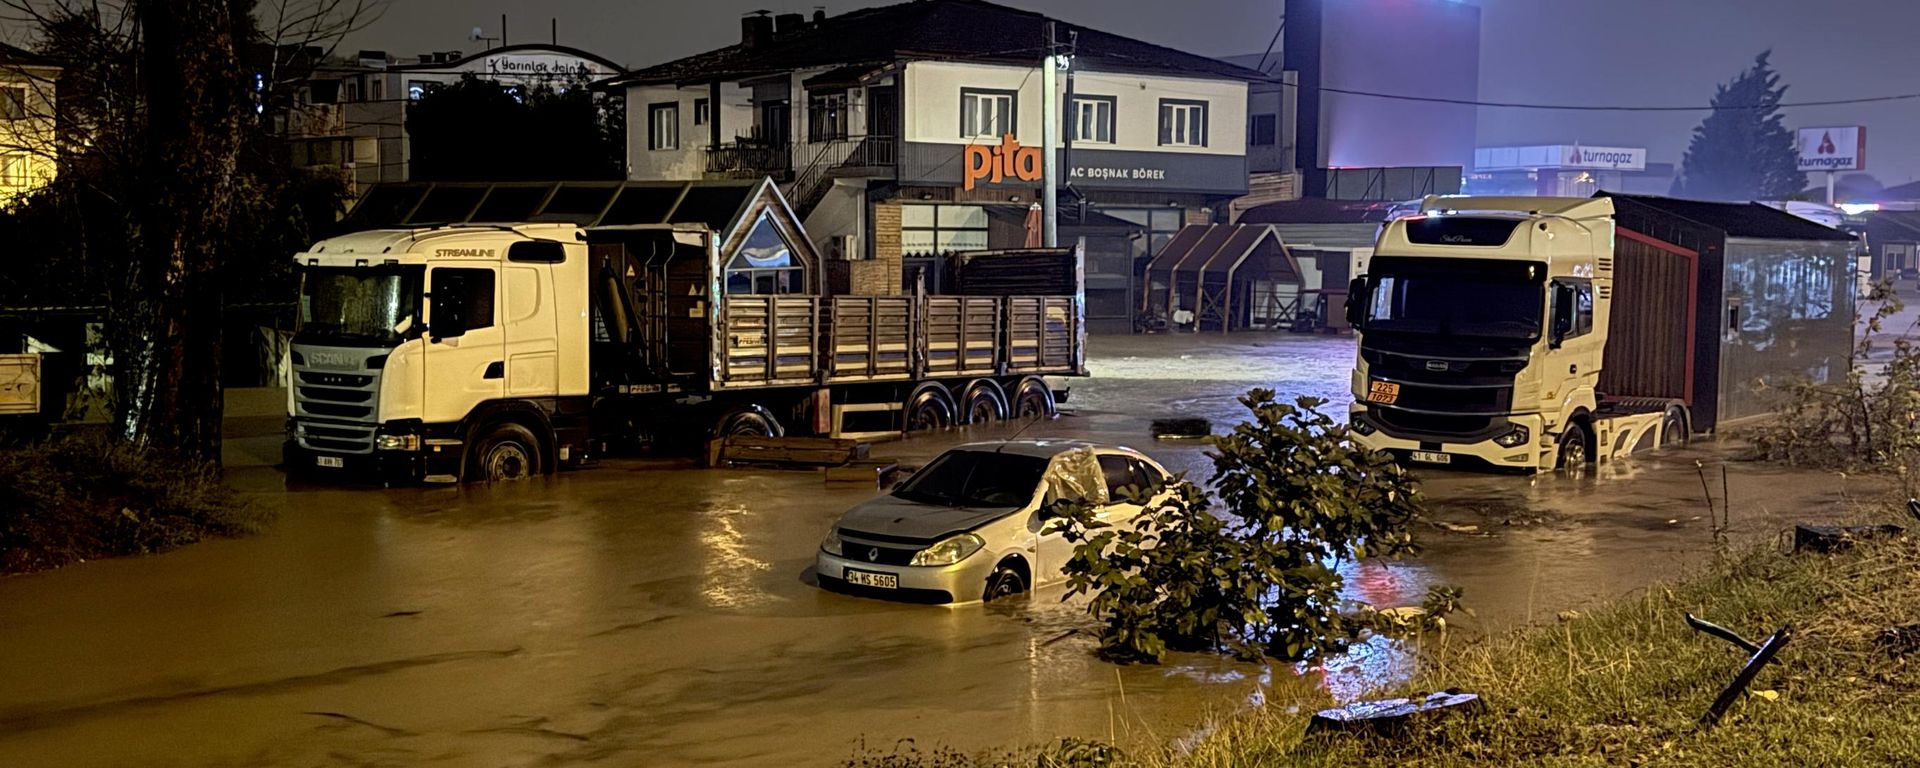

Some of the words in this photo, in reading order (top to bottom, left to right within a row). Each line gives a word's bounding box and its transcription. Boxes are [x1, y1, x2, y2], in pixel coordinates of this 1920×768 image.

[965, 133, 1042, 191] pita
[1584, 149, 1632, 167] turnagaz
[1799, 157, 1852, 168] turnagaz
[1088, 168, 1128, 180] BOŞNAK
[1132, 168, 1165, 179] BÖREK
[435, 249, 495, 257] STREAMLINE
[311, 352, 357, 366] SCAN
[1377, 383, 1394, 393] 225
[1371, 393, 1394, 402] 1073
[849, 571, 858, 582] 34
[873, 575, 895, 588] 5605
